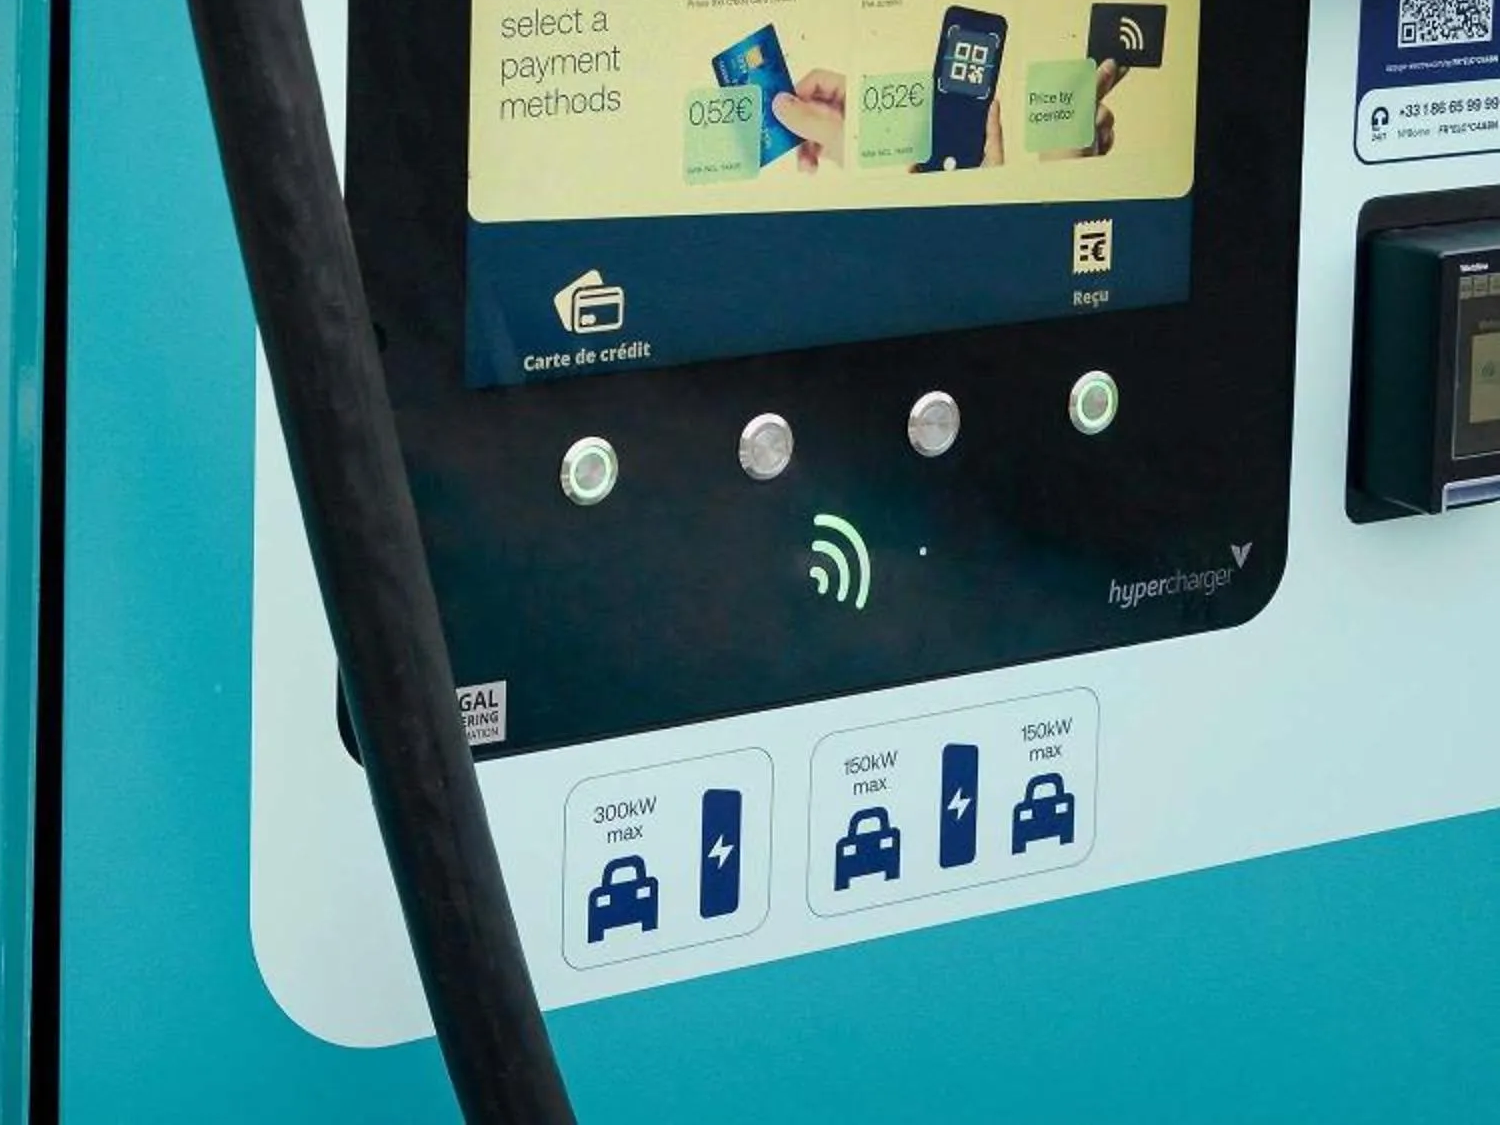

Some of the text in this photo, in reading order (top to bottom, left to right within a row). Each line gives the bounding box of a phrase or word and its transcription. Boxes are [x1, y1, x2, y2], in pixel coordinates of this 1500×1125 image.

[501, 7, 609, 39] select a
[501, 45, 621, 87] payment
[500, 84, 621, 120] methods
[864, 82, 925, 113] 0,52€
[1059, 90, 1074, 105] by
[689, 97, 753, 128] 0,52€
[1073, 290, 1109, 308] Reçu
[523, 341, 651, 371] Carte de crédit
[1108, 567, 1234, 609] hypercharger
[460, 689, 499, 712] GAL
[461, 710, 499, 727] ERING
[1021, 716, 1073, 742] 150kW
[844, 750, 899, 776] 150kW
[1029, 744, 1062, 762] max
[853, 777, 887, 796] max
[593, 795, 657, 824] 300kW
[607, 825, 643, 844] max
